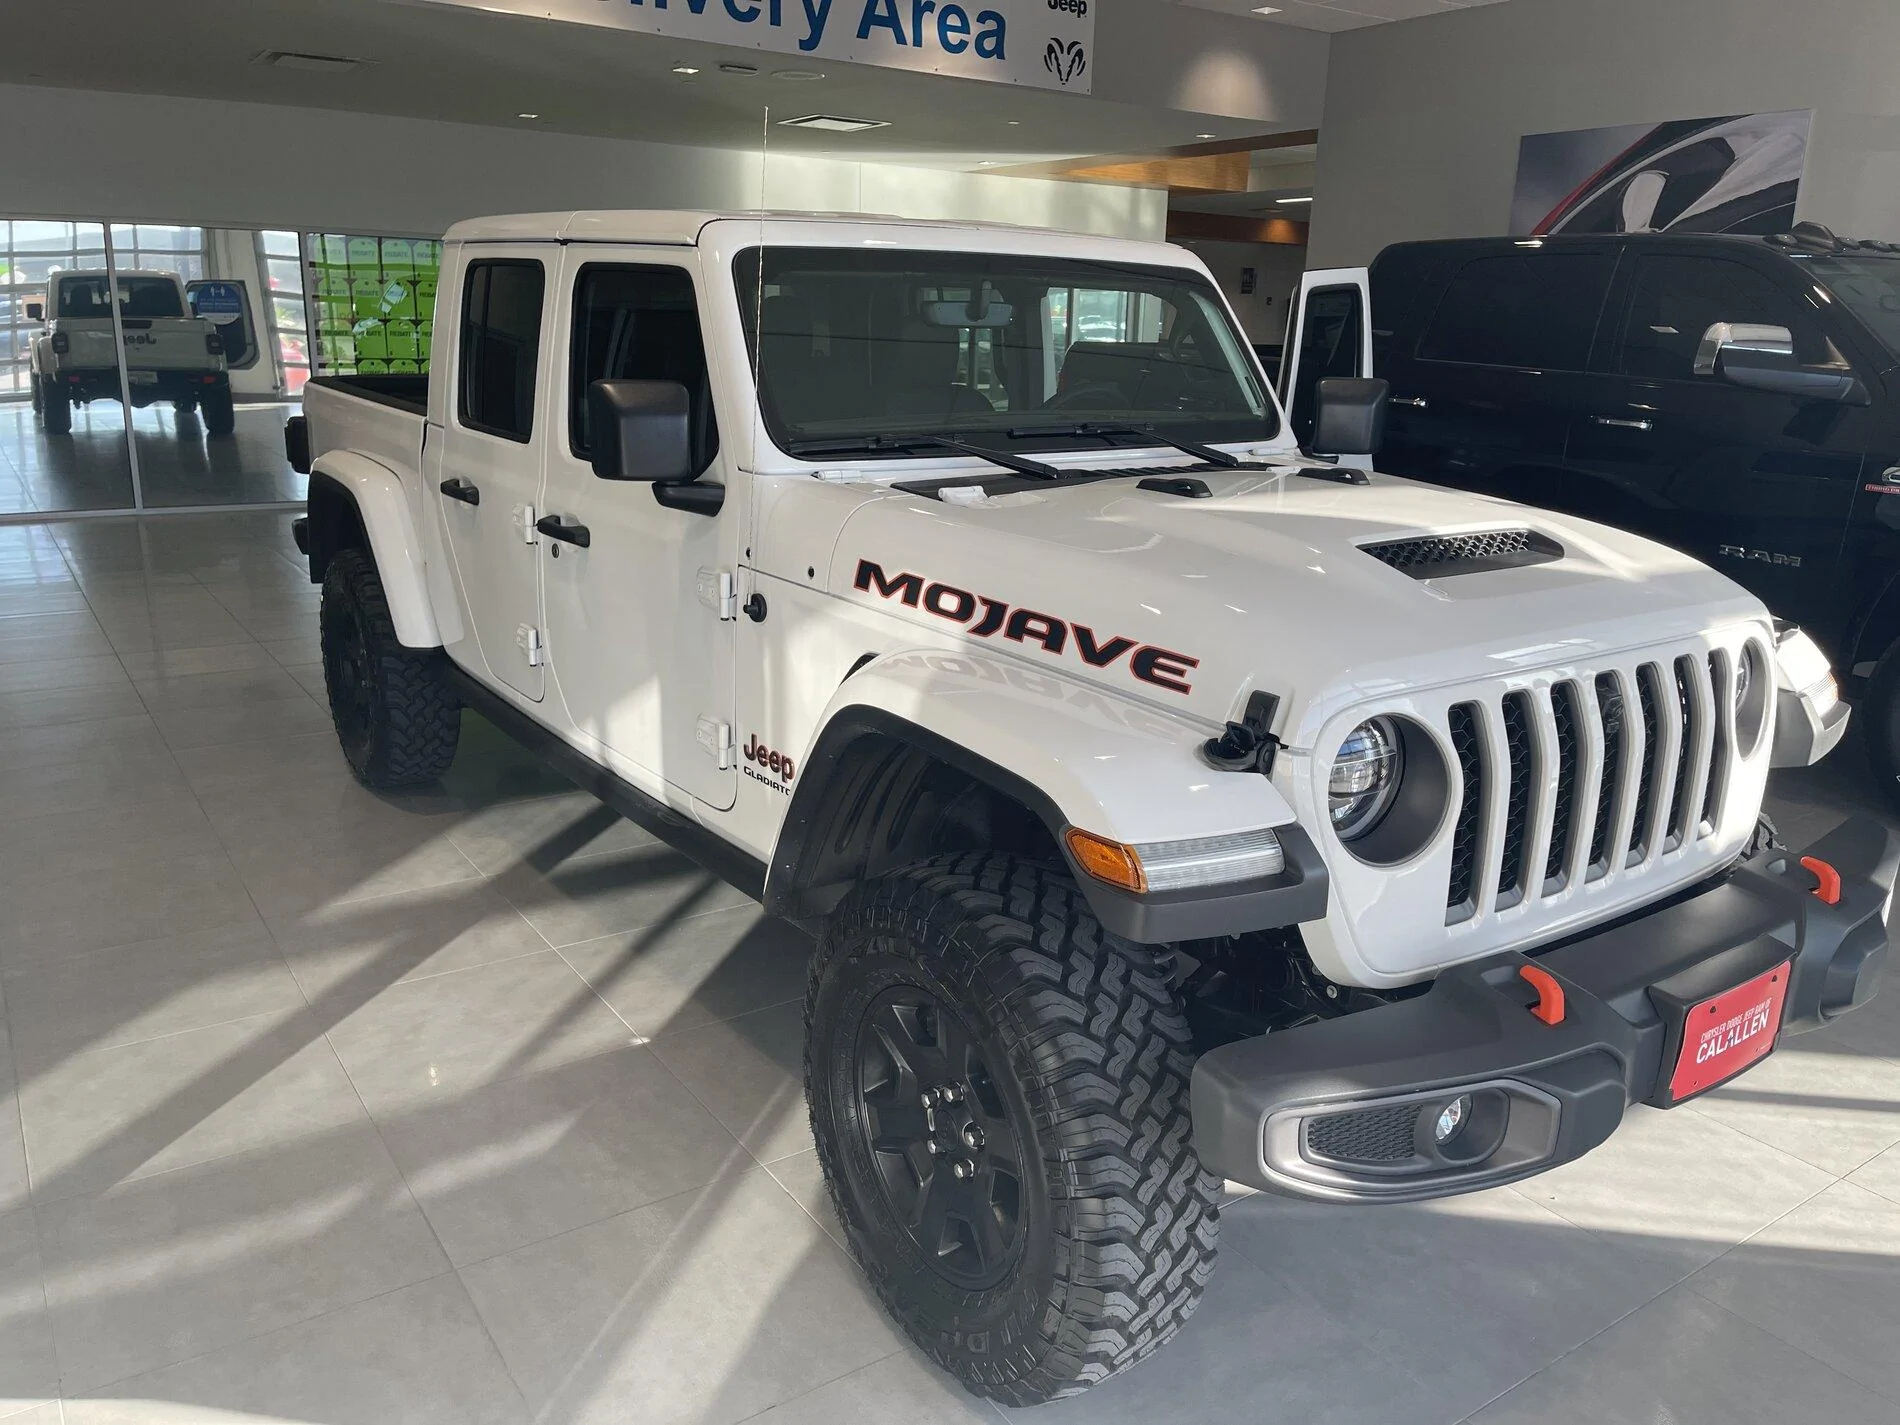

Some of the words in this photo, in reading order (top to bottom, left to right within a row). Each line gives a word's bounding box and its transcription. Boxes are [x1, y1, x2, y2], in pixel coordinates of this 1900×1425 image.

[856, 0, 1006, 60] Area
[1719, 544, 1802, 567] RAM
[853, 558, 1200, 695] MOJAVE
[743, 733, 796, 783] Jeep
[743, 766, 791, 796] GLADIATO
[1696, 1008, 1770, 1064] CALALLEN
